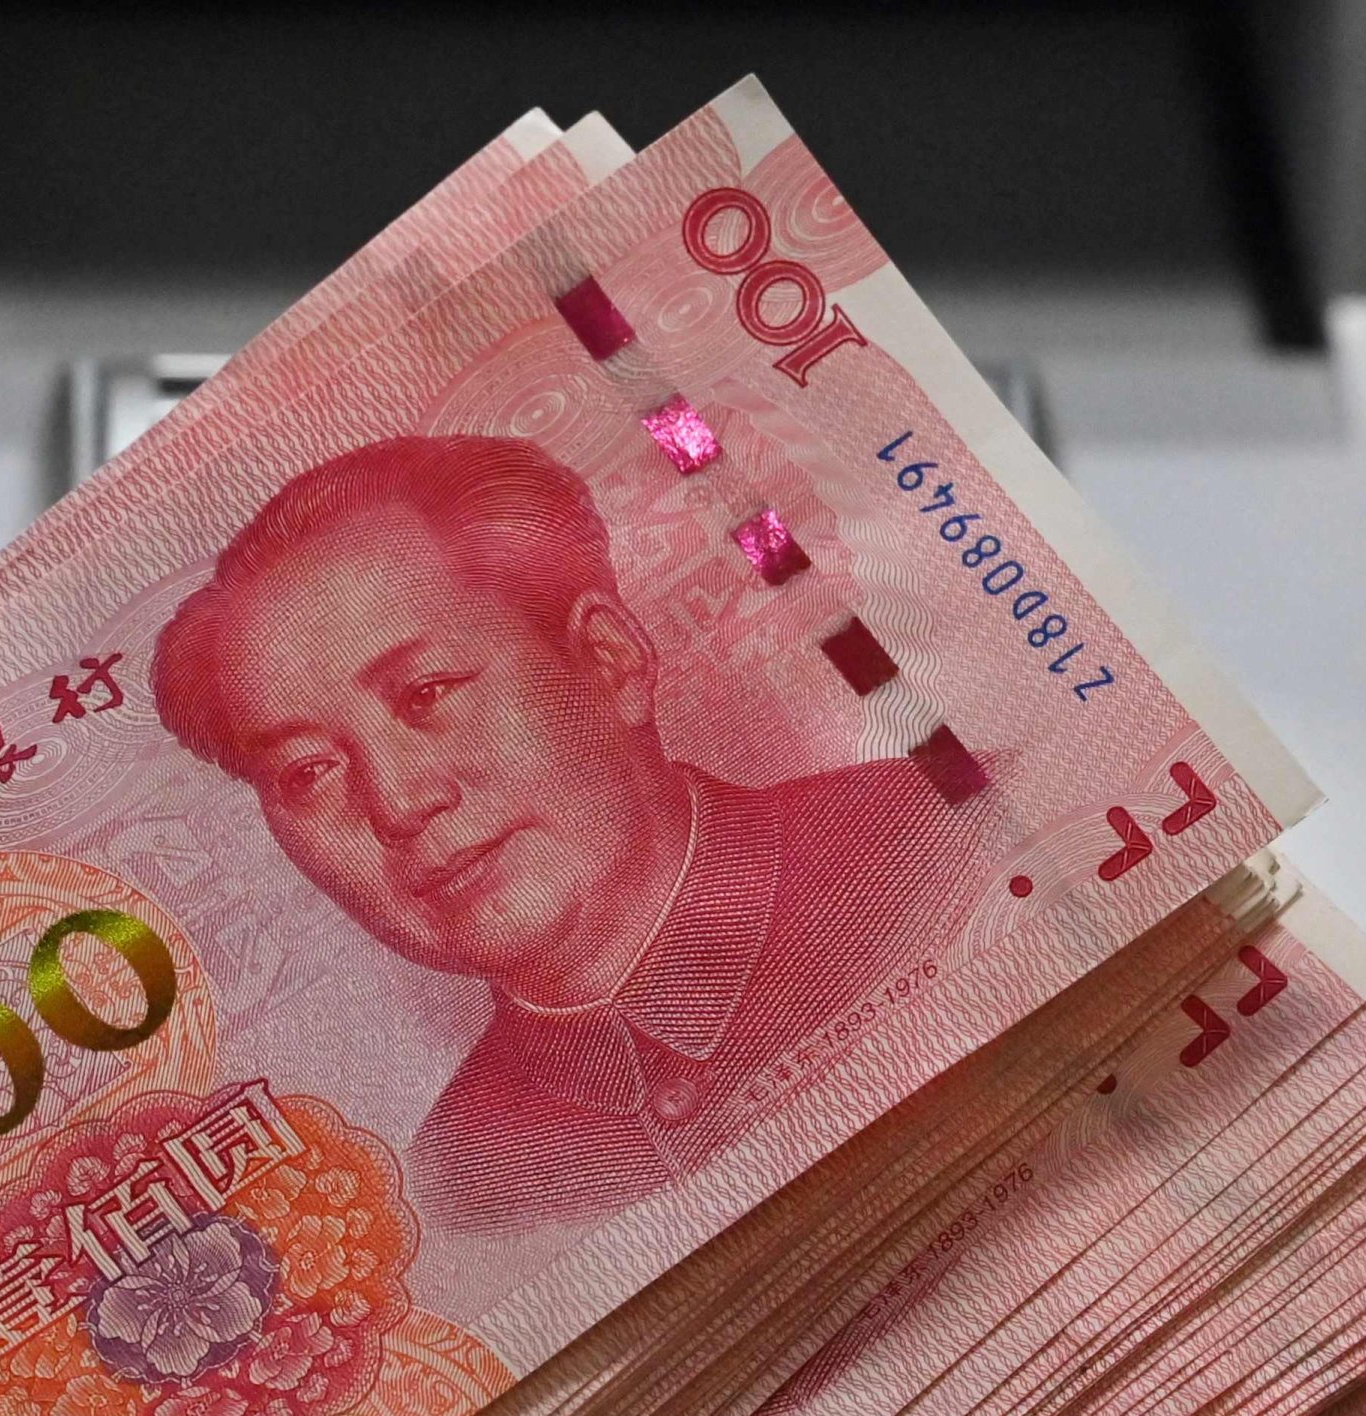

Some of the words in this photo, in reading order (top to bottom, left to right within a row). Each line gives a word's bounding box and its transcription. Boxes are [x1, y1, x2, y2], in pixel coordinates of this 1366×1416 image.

[681, 185, 870, 389] 100
[876, 430, 1114, 704] Z18D089491
[823, 959, 938, 1048] 1893-1976
[929, 1162, 1034, 1260] 1893-1976
